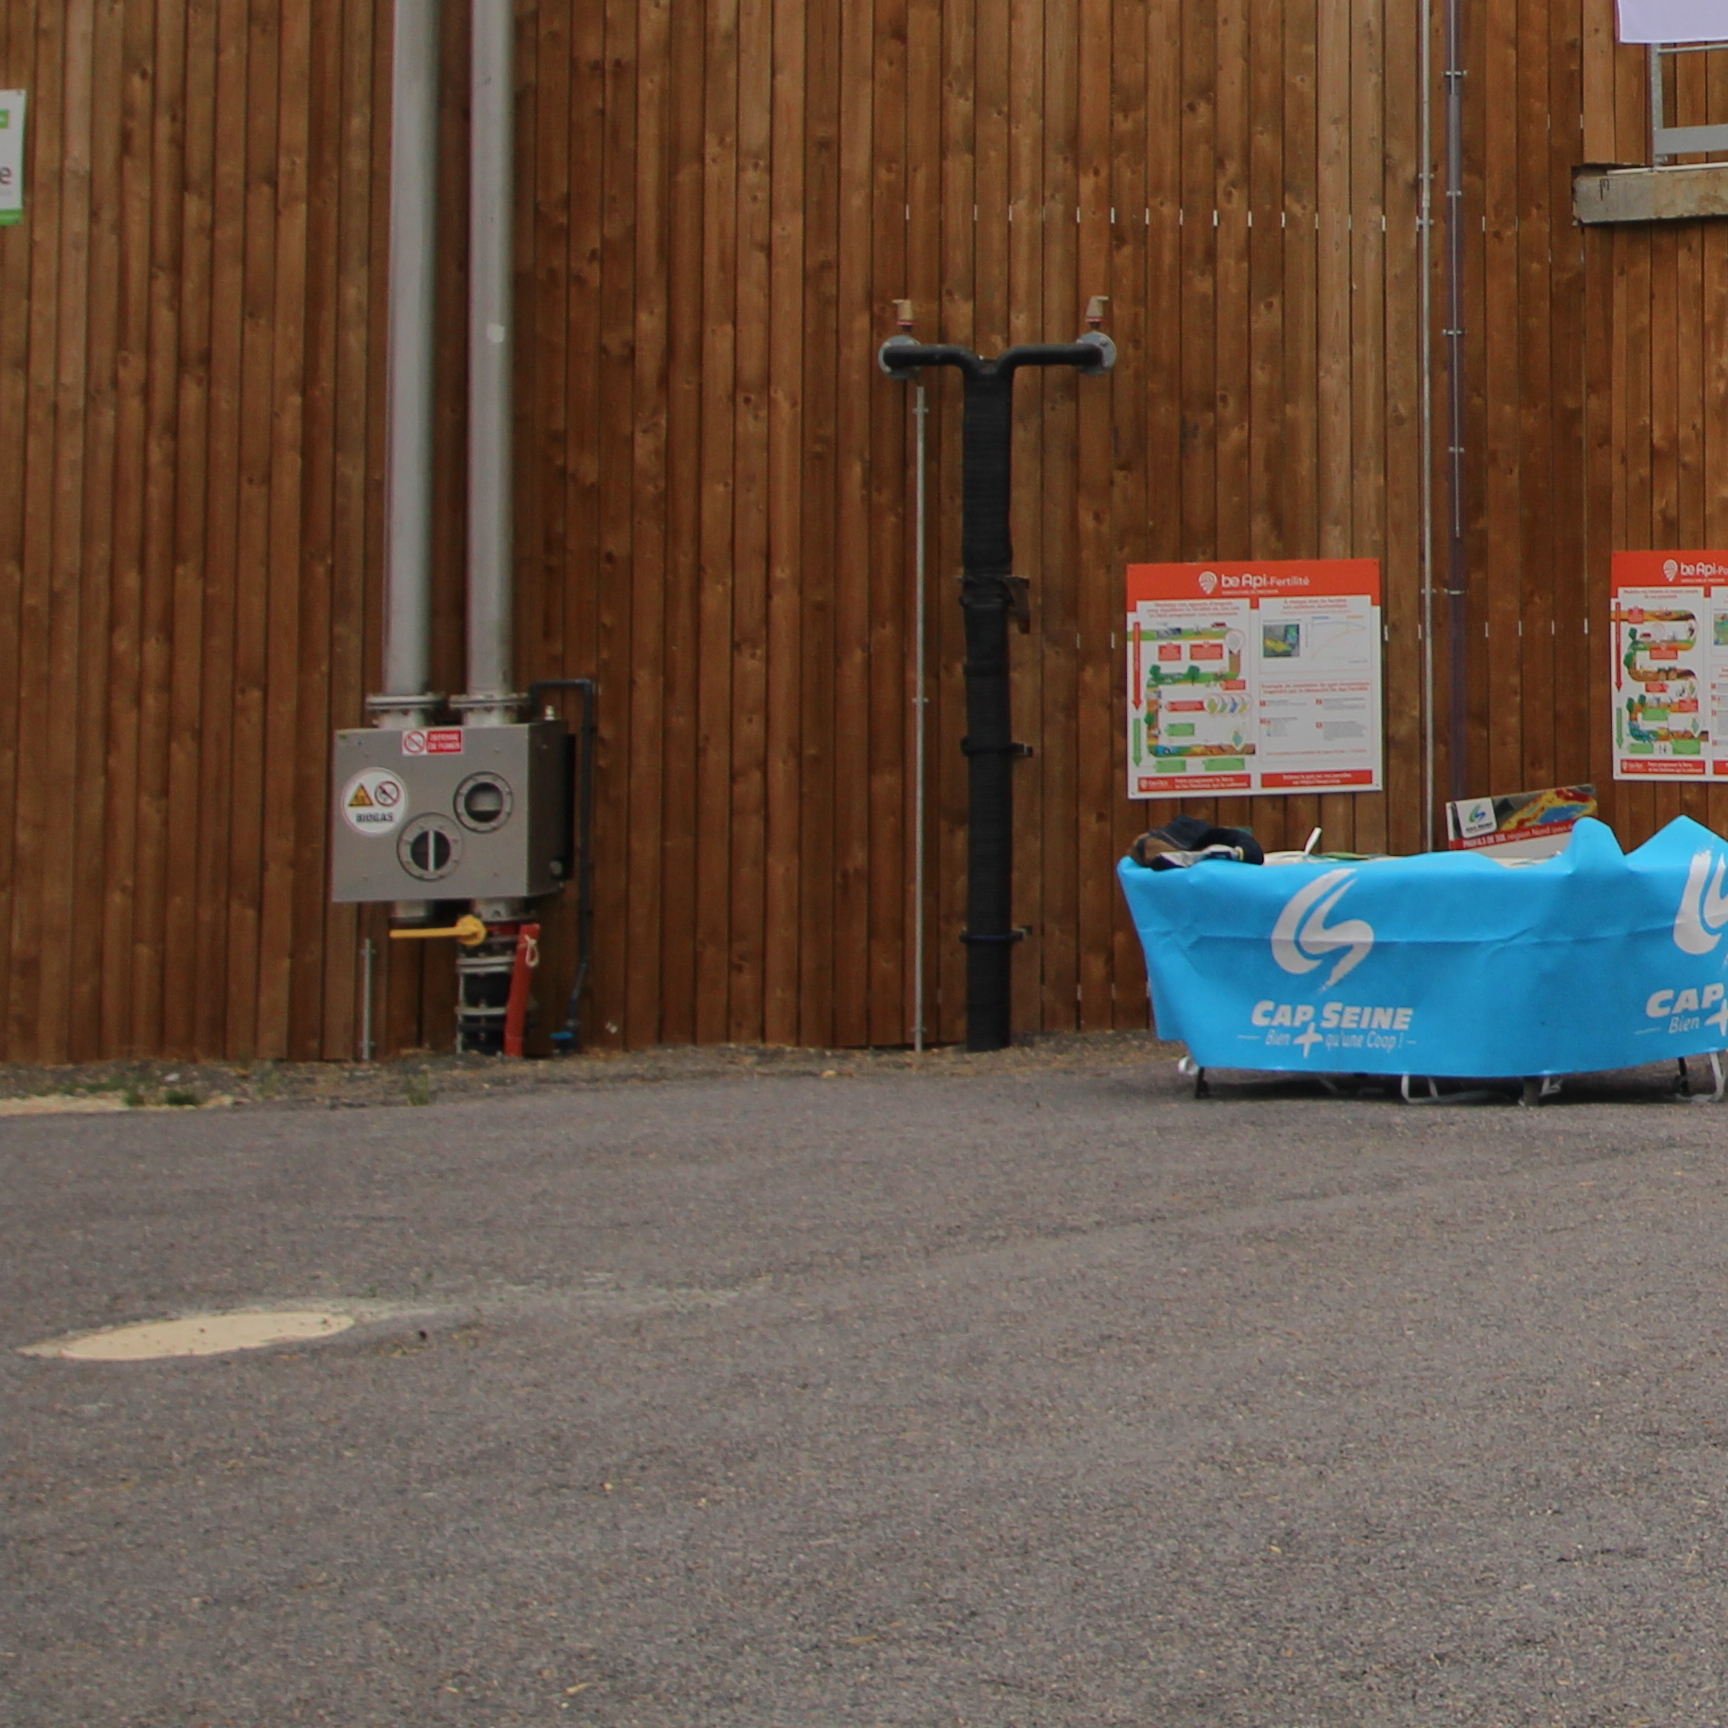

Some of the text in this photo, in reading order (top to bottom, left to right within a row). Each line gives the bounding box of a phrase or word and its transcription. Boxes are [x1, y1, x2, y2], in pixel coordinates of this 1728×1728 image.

[1680, 562, 1695, 576] be
[1221, 573, 1240, 588] be
[355, 812, 394, 823] BIOGAS
[1645, 982, 1725, 1018] CAP
[1251, 1000, 1415, 1031] CAP SEINE
[1668, 1015, 1700, 1034] Bien
[1265, 1029, 1292, 1046] Bien
[1325, 1032, 1364, 1052] qu'une
